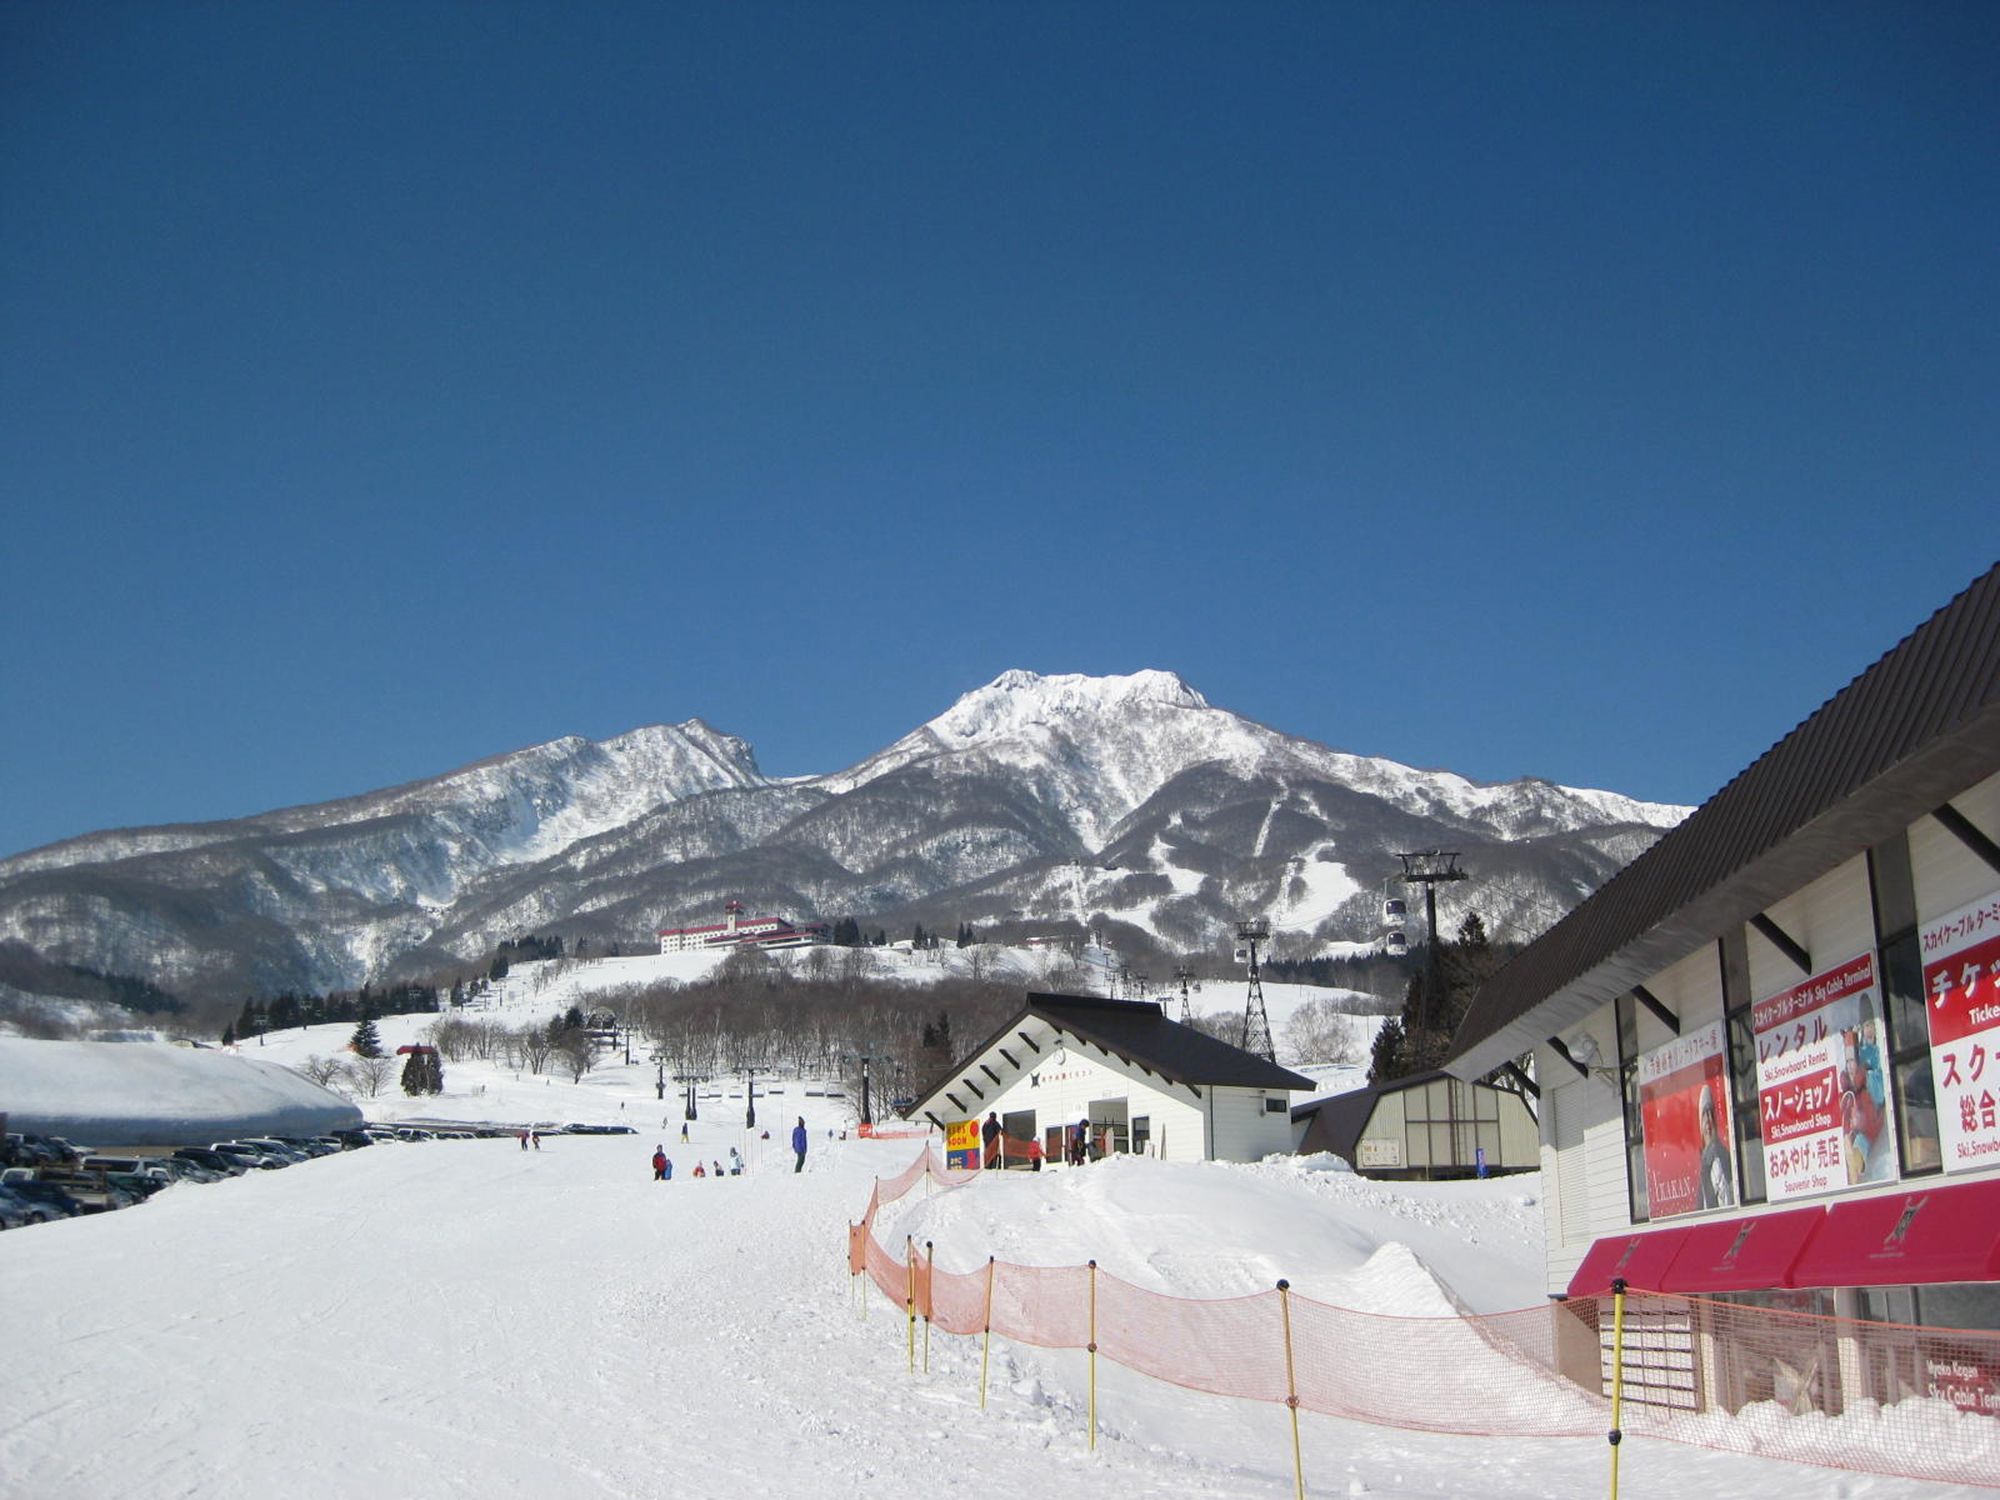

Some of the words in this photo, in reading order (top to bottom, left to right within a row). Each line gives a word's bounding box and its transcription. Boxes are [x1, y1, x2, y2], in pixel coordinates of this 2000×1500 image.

[1923, 903, 2000, 952] スカイケーブルターミ
[1827, 976, 1843, 996] Cable
[1844, 961, 1871, 987] Terminal
[1759, 1015, 1827, 1065] レンタル
[1808, 1049, 1829, 1067] Rental
[1764, 1071, 1833, 1121] スノーショップ
[1960, 1088, 2000, 1132] 総合
[1815, 1112, 1832, 1128] Shop
[1784, 1175, 1811, 1194] Souvenir
[1811, 1174, 1828, 1190] Shop
